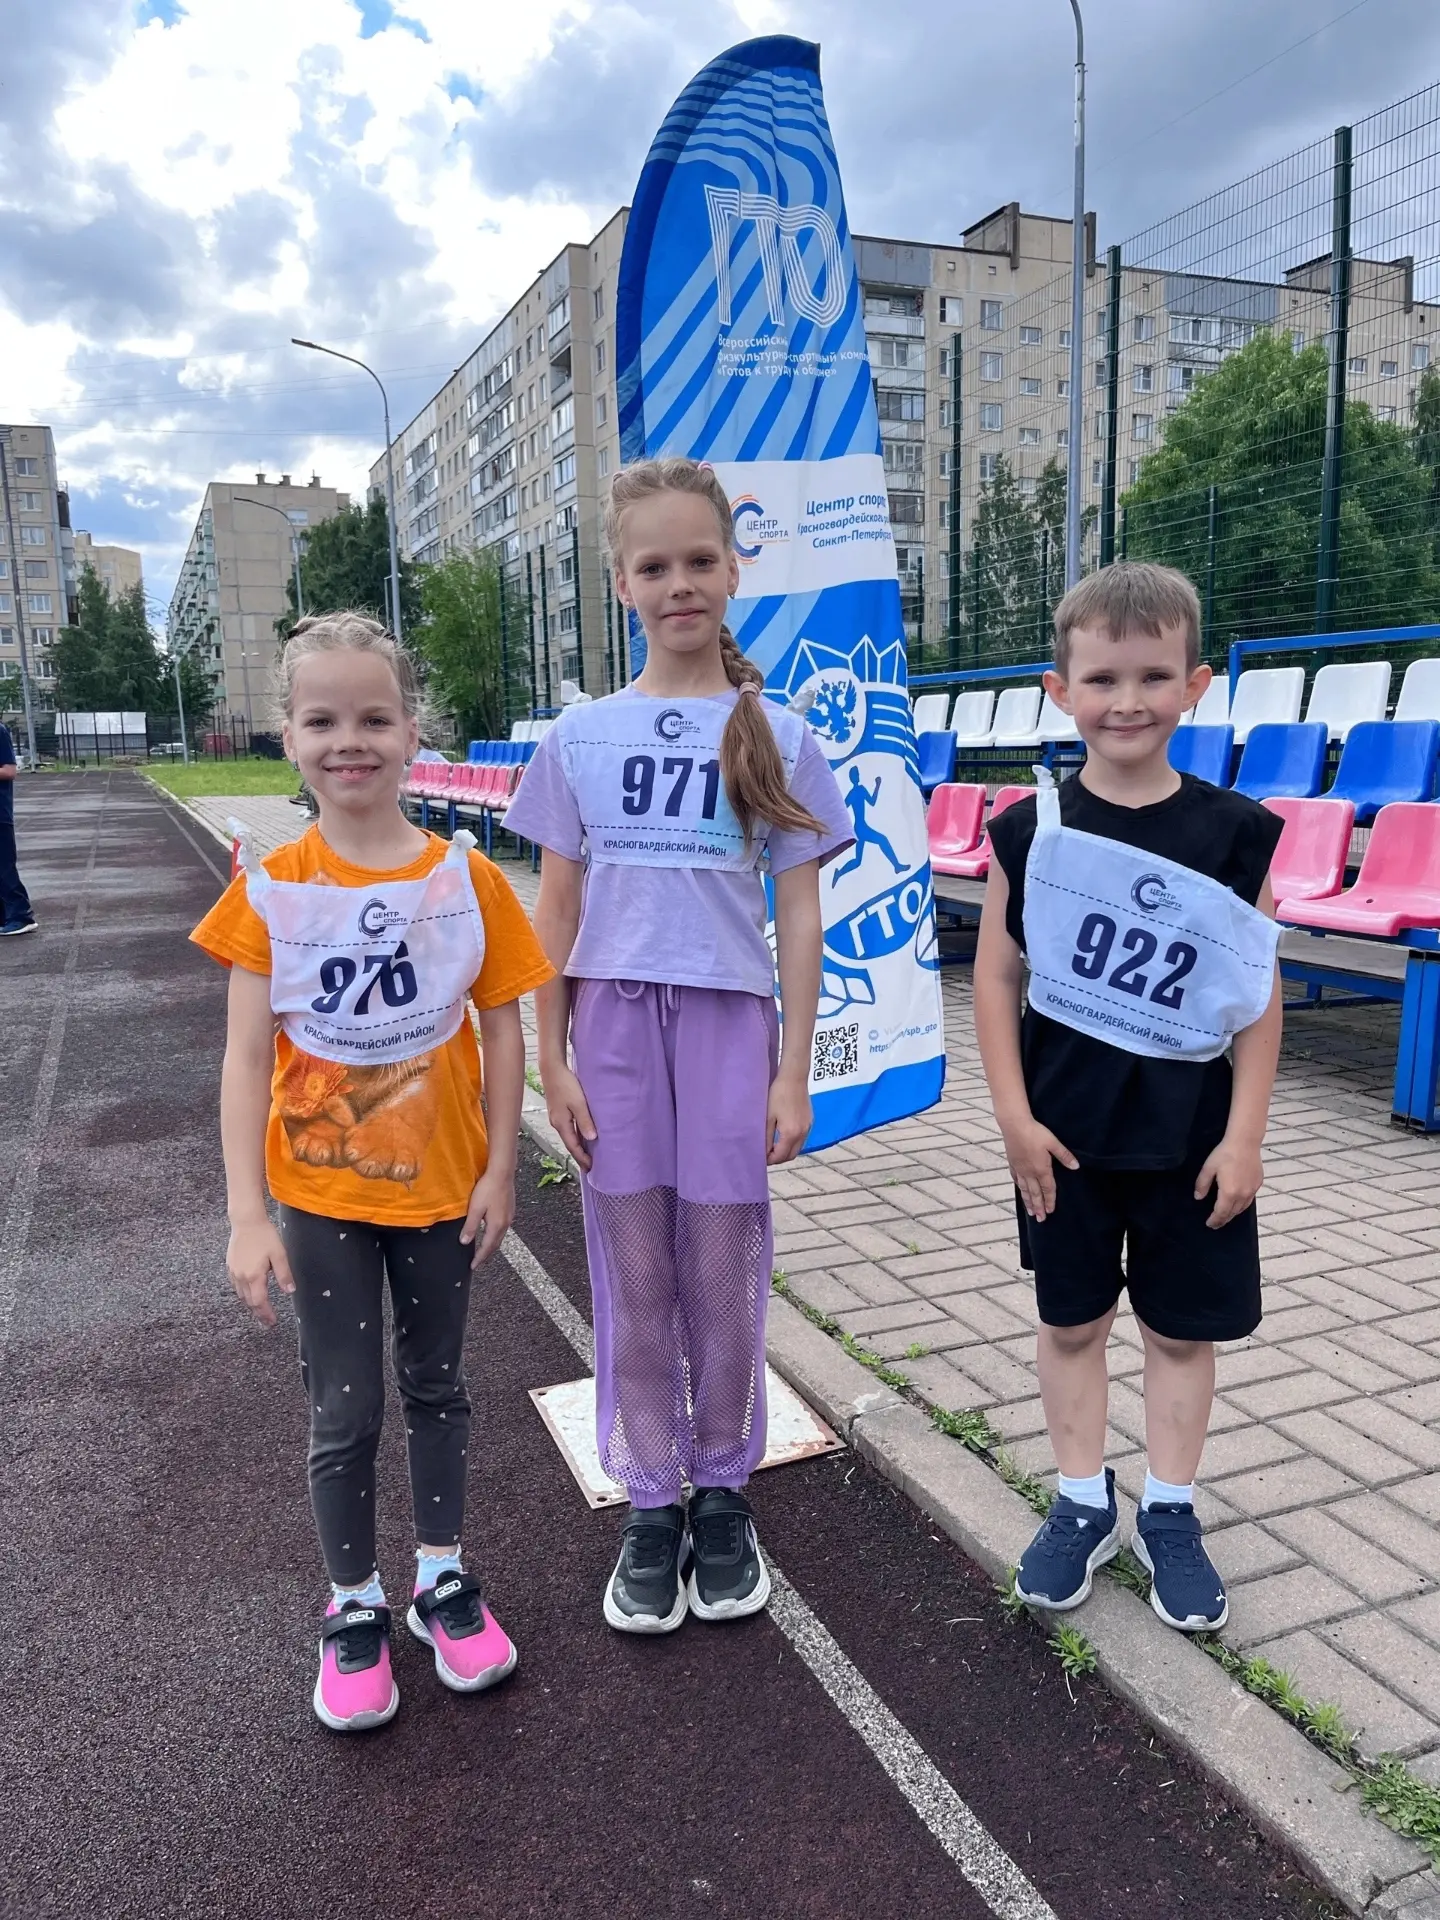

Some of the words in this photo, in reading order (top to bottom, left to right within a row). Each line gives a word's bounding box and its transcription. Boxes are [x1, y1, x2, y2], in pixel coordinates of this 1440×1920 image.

[754, 366, 762, 376] к
[793, 368, 800, 376] и
[806, 496, 855, 517] Центр
[746, 519, 779, 532] ЦЕНТР
[759, 530, 790, 539] СПОРТА
[621, 754, 720, 820] 971
[603, 839, 696, 854] КРАСНОГВАРДЕЙСКИЙ
[697, 844, 728, 857] РАЙОН
[1150, 888, 1176, 900] ЦЕНТР
[1158, 897, 1182, 908] СПОРТА
[372, 911, 400, 920] ЦЕНТР
[848, 881, 923, 958] ГТО
[1071, 912, 1199, 1010] 922
[311, 940, 418, 1016] 976
[1046, 992, 1151, 1039] КРАСНОГВАРДЕЙСКИЙ
[1151, 1032, 1183, 1049] РАЙОН
[303, 1023, 402, 1051] КРАСНОГВАРДЕЙСКИЙ
[403, 1024, 435, 1043] РАЙОН
